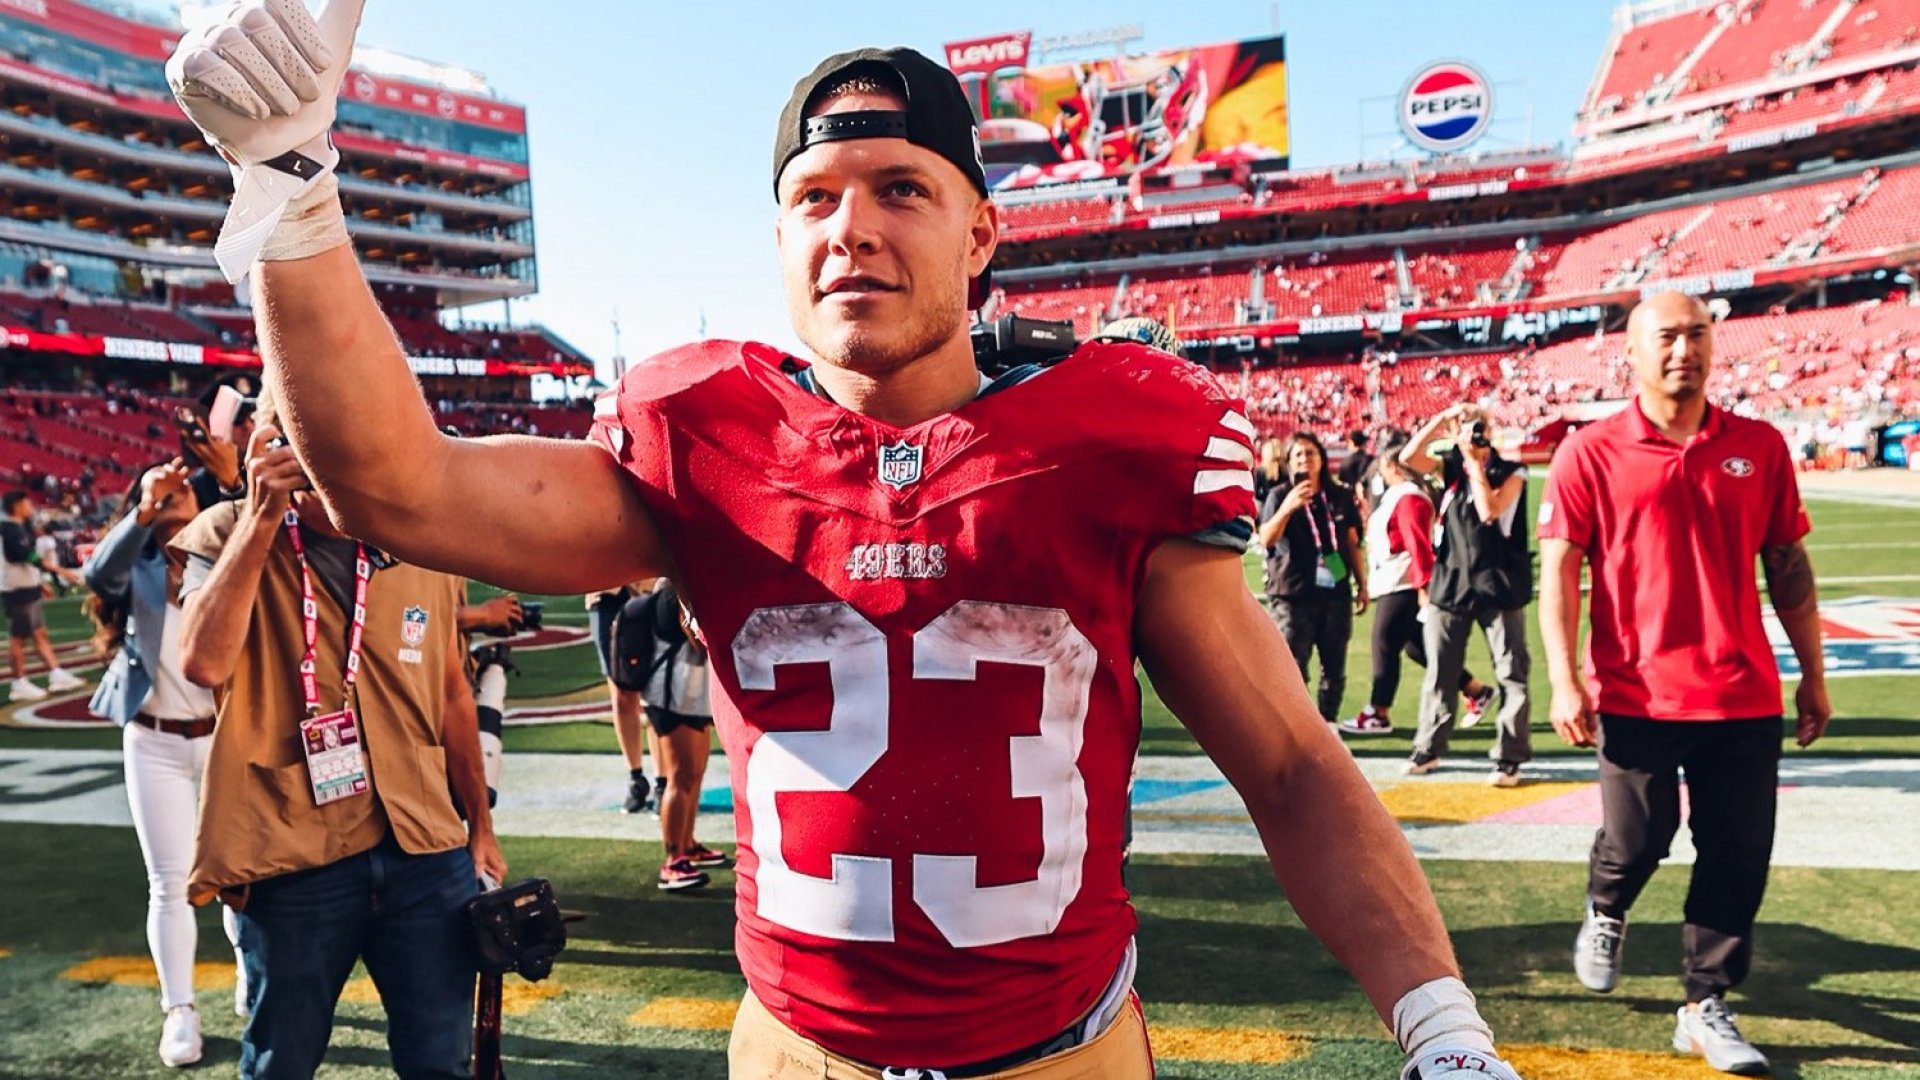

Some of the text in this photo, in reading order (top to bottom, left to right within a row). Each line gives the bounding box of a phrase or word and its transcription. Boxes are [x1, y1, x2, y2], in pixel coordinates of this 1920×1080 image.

[1411, 93, 1481, 115] PEPSI
[1298, 313, 1402, 334] NINERS WIN
[168, 342, 204, 364] WIN
[886, 461, 916, 480] NFL
[845, 543, 947, 580] 49ERS
[731, 600, 1097, 949] 23
